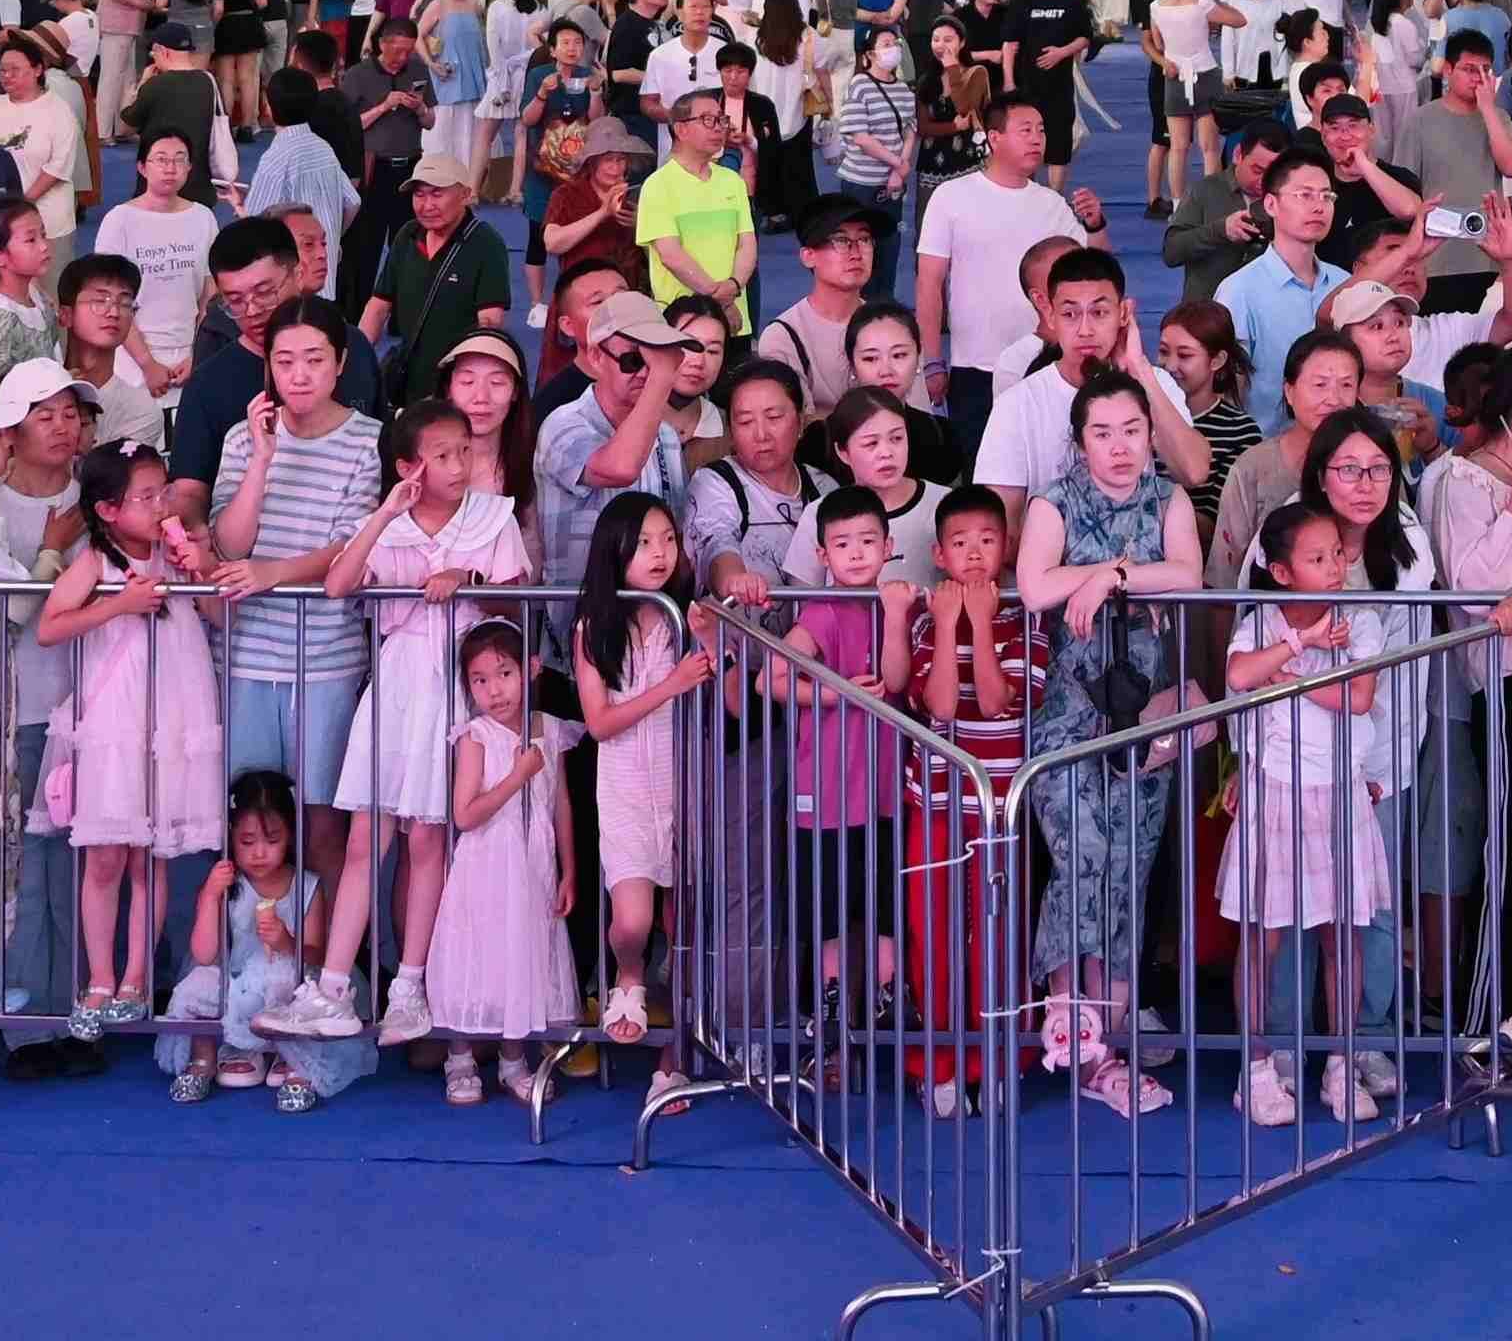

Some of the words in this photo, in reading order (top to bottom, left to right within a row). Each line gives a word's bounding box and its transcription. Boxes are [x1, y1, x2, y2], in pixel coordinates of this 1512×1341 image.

[136, 245, 166, 262] Enjoy
[167, 243, 195, 255] Your
[140, 258, 167, 276] Free
[169, 258, 196, 271] Time
